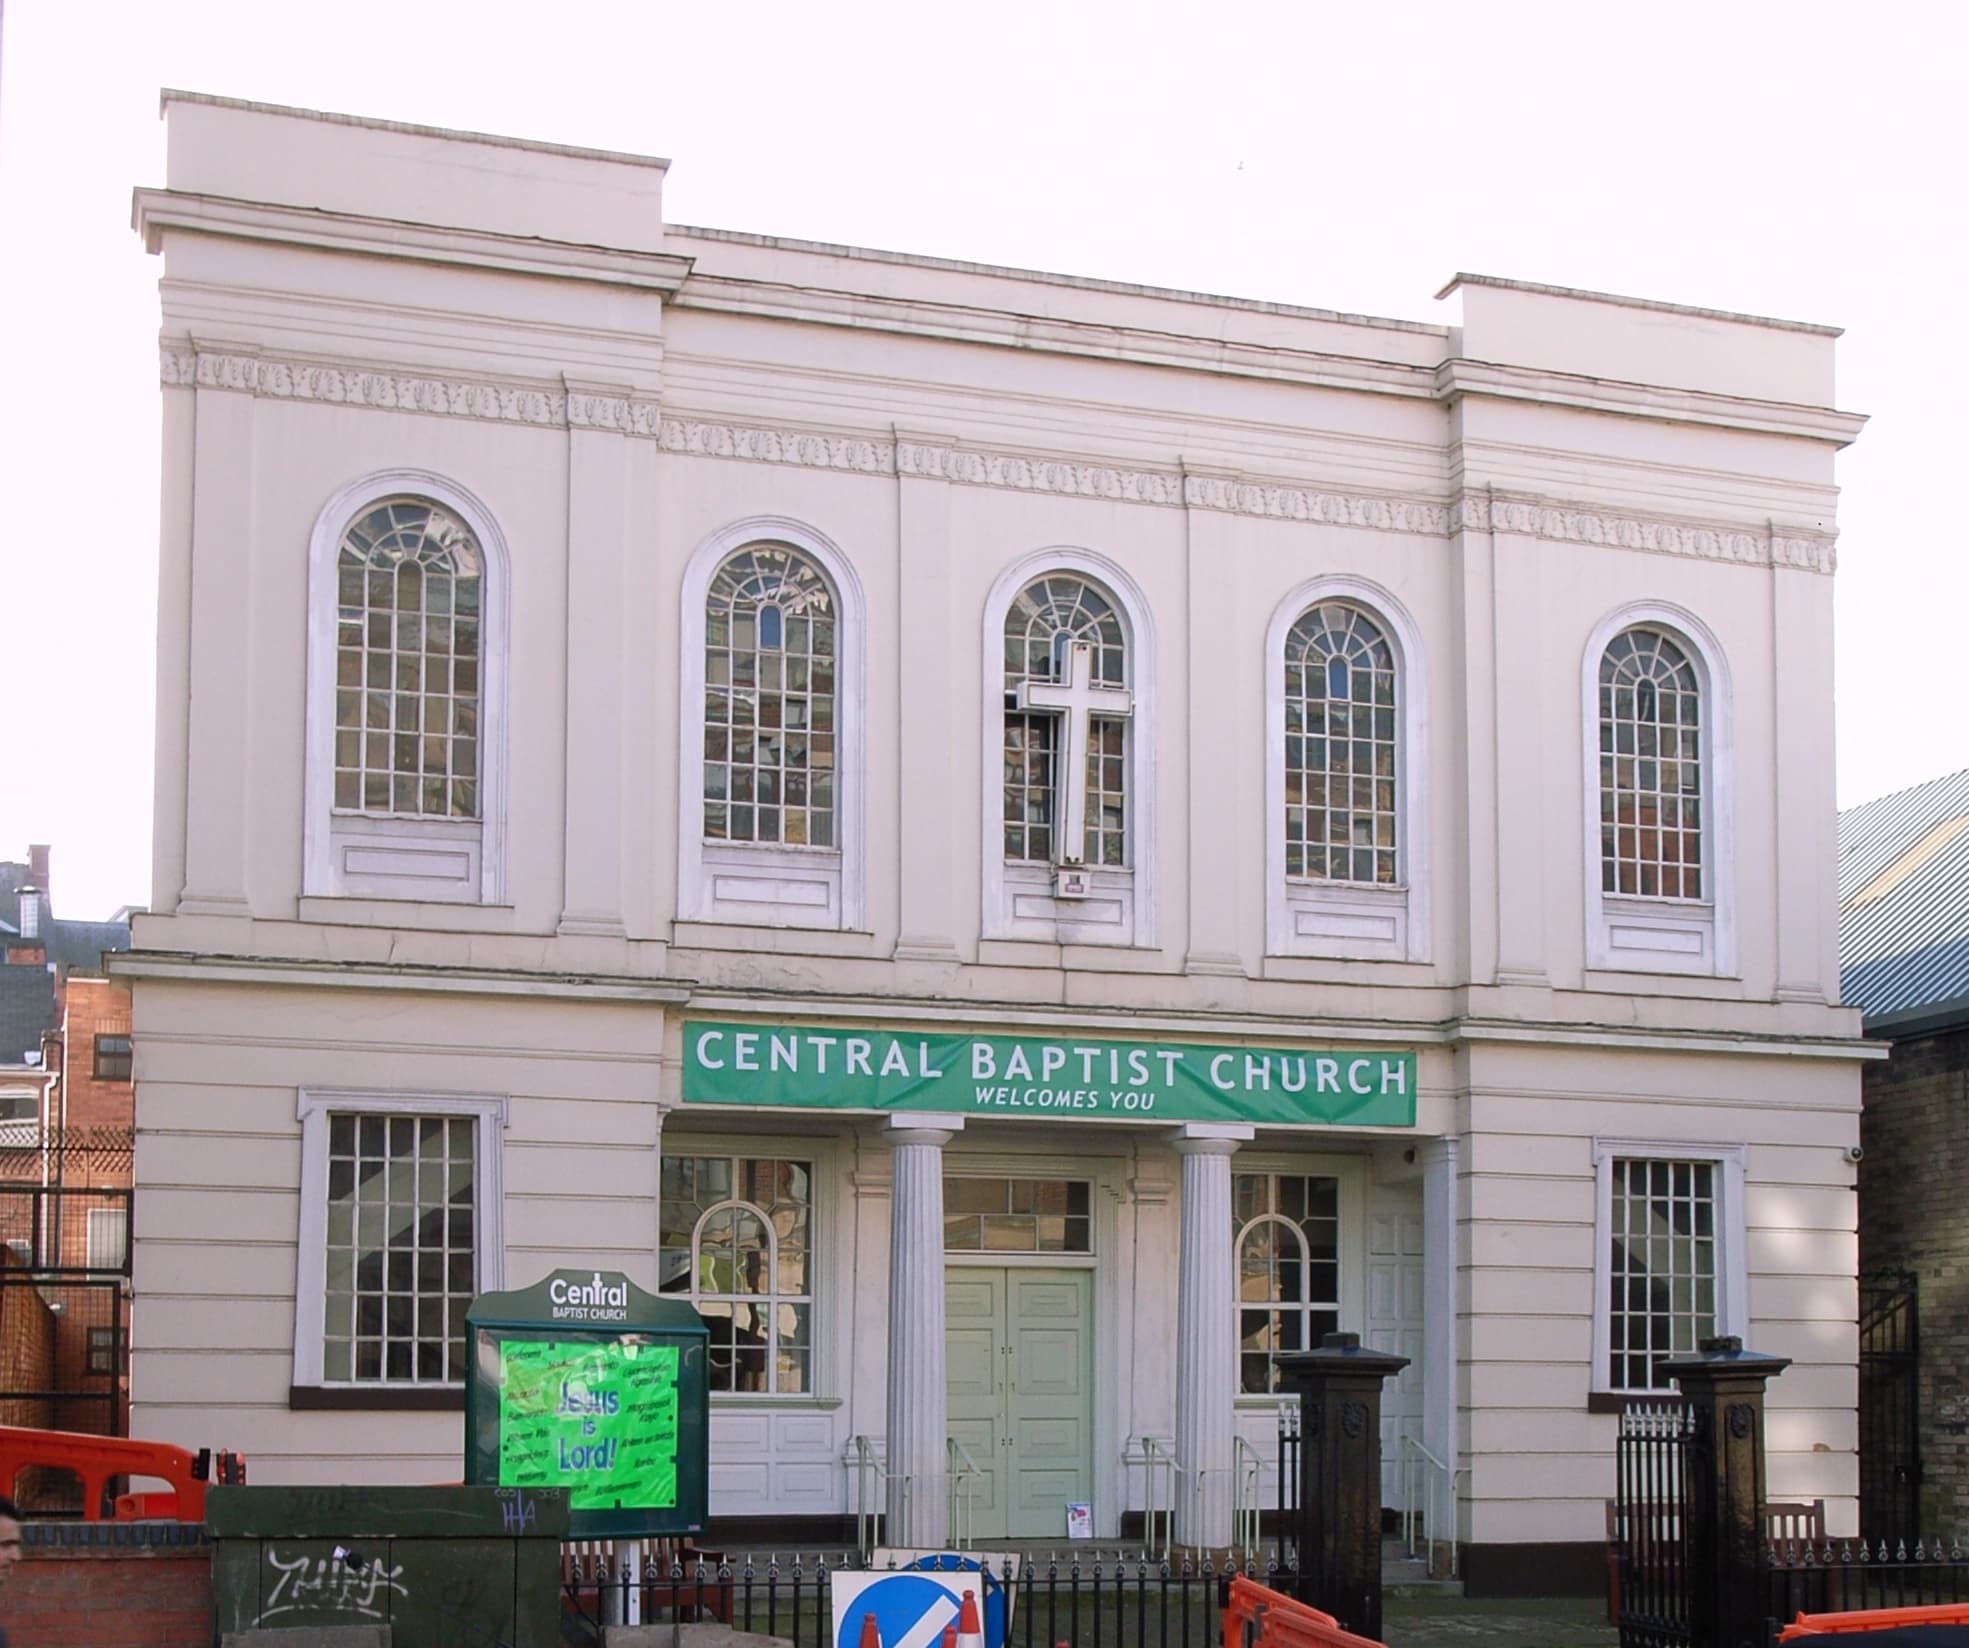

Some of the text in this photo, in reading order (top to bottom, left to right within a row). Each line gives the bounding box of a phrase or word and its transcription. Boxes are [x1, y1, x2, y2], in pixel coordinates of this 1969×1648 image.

[696, 1031, 1405, 1095] CENTRAL BAPTIST CHURCH
[975, 1086, 1155, 1110] WELCOMES YOU
[550, 1272, 627, 1306] Central
[553, 1306, 627, 1320] BAPTIST CHURCH
[582, 1415, 597, 1435] is
[559, 1437, 618, 1470] Lord!
